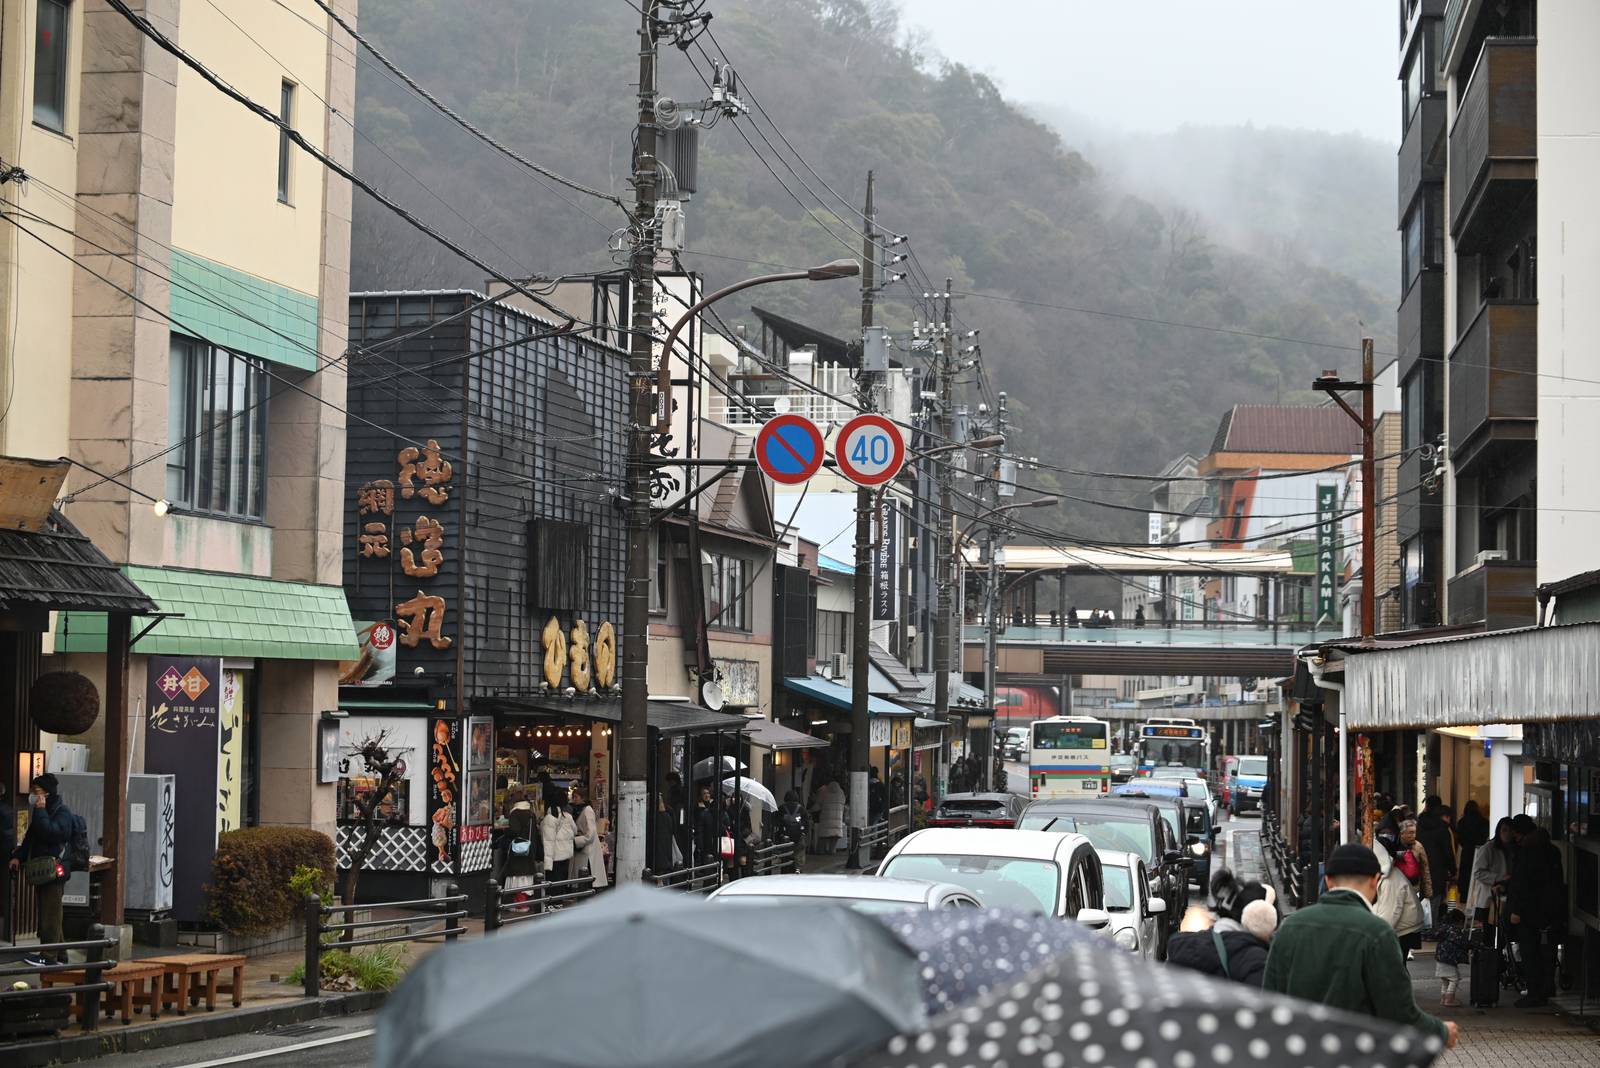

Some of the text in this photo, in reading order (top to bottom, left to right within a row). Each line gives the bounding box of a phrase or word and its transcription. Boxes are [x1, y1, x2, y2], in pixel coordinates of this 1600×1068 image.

[851, 435, 890, 466] 40
[163, 674, 202, 693] 丼 甘
